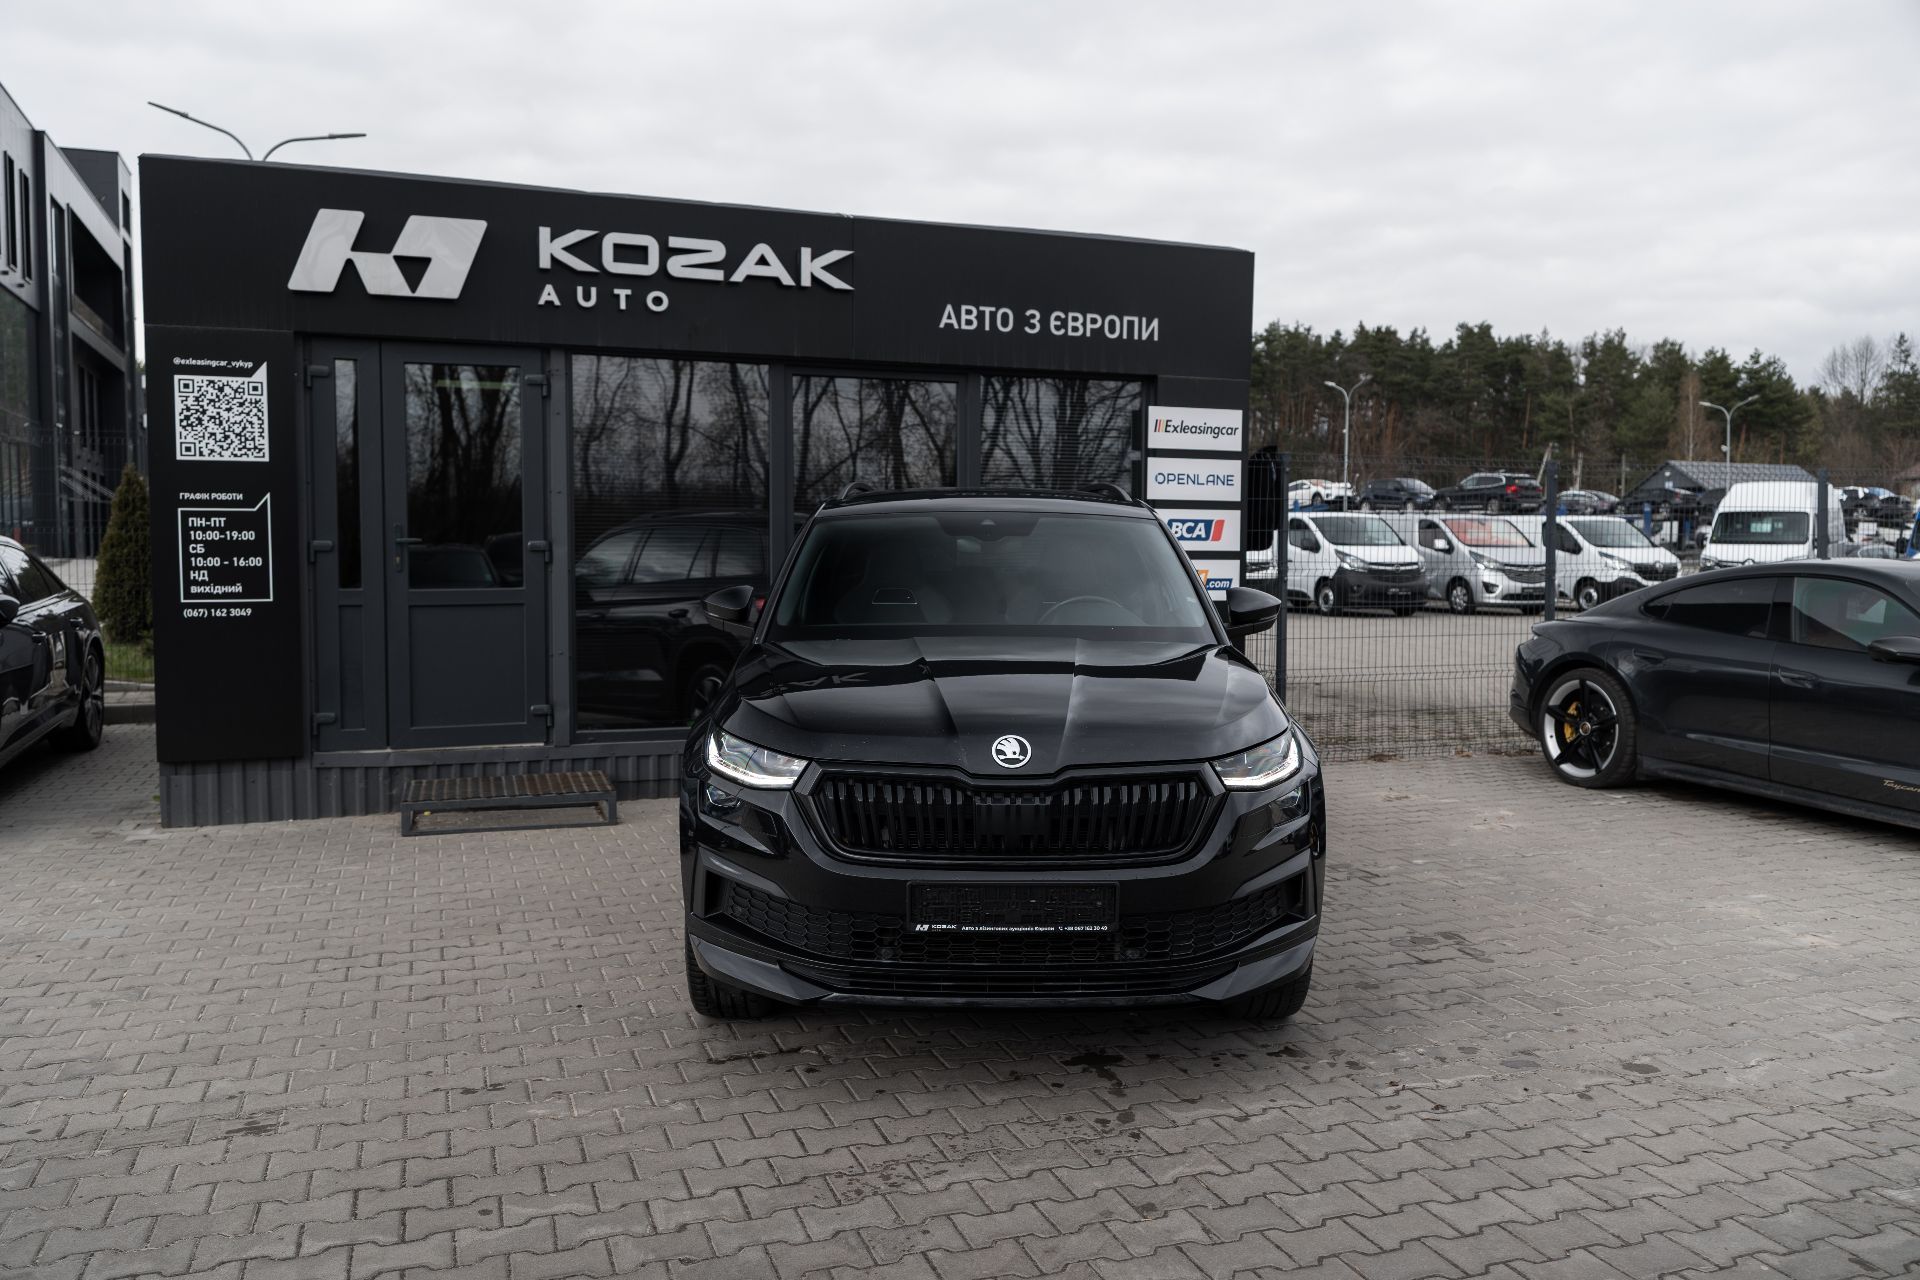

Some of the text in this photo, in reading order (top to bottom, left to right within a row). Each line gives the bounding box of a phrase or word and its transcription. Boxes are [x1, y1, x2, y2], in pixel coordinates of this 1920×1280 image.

[539, 226, 855, 290] KOZAK
[538, 284, 669, 312] AUTO
[939, 304, 1014, 332] АВТО
[1050, 311, 1159, 341] ЄВРОПИ
[173, 357, 253, 368] @exleasingcar_vykyp
[1164, 419, 1239, 439] Exleasingcar
[1155, 472, 1235, 486] OPENLANE
[188, 517, 226, 527] ПН-ПТ
[1171, 521, 1206, 538] BCA
[190, 531, 255, 540] 10:00-19:00
[189, 544, 205, 553] СБ
[190, 557, 221, 567] 10:00
[232, 557, 262, 567] 16:00
[190, 570, 209, 581] НД
[190, 583, 242, 594] вихідний
[183, 608, 252, 618] (067) 162 3049
